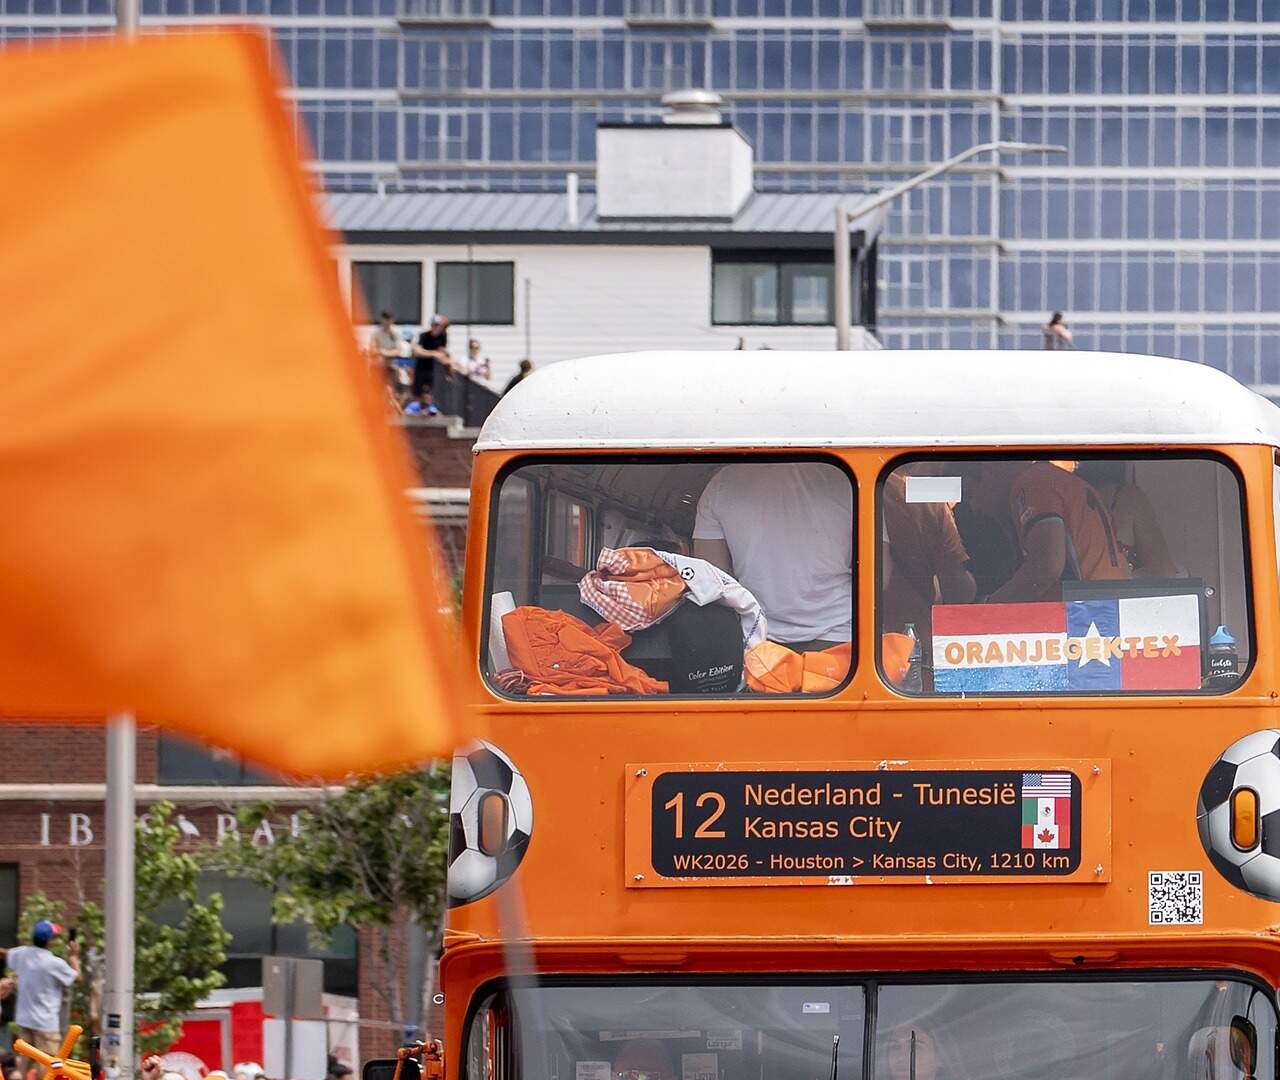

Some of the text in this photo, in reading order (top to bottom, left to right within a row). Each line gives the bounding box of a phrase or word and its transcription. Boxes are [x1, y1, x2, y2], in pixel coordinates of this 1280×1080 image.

[944, 634, 1181, 665] ORANJEGEKTEX
[688, 664, 734, 681] Color Edition
[744, 783, 881, 806] Nederland
[913, 783, 1016, 805] Tunesië
[663, 791, 727, 839] 12
[744, 817, 901, 843] Kansas City
[673, 854, 749, 870] WK2026
[770, 854, 845, 870] Houston
[873, 854, 936, 869] Kansas
[942, 853, 982, 872] City,
[991, 853, 1034, 868] 1210
[1042, 853, 1071, 868] km
